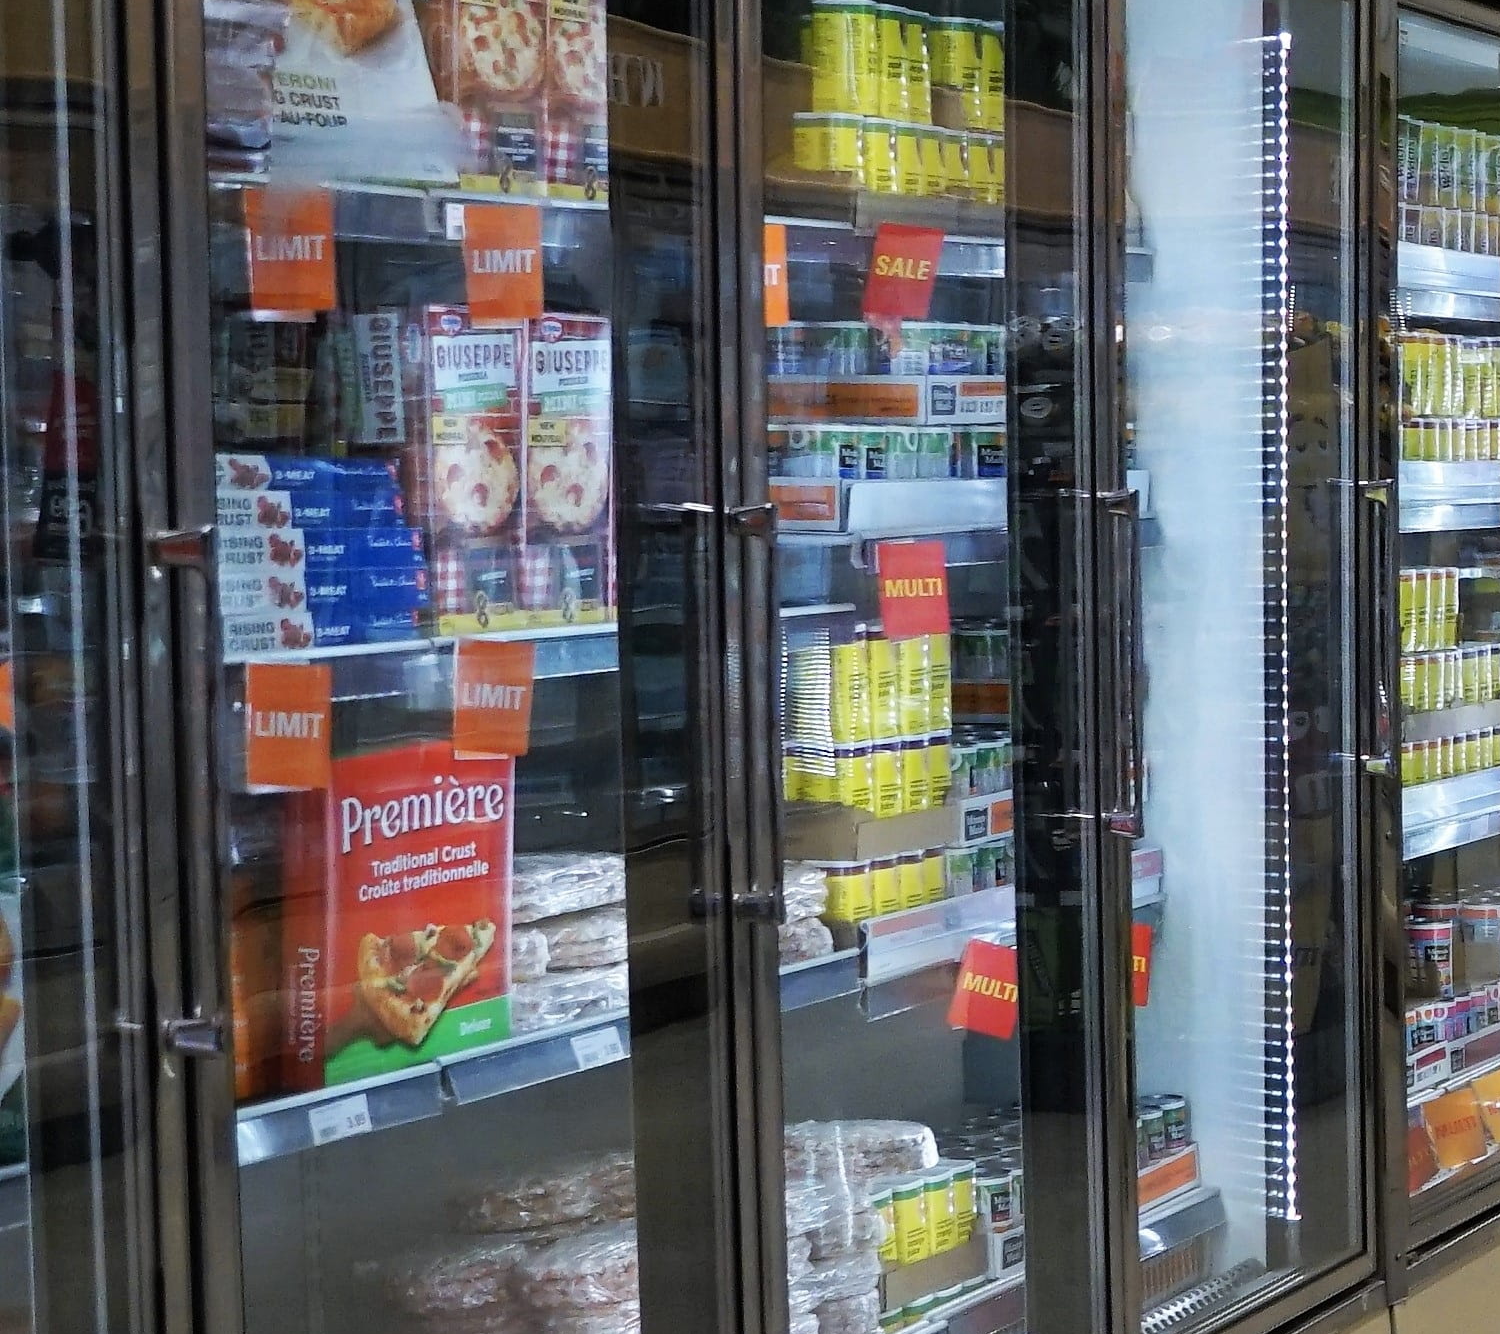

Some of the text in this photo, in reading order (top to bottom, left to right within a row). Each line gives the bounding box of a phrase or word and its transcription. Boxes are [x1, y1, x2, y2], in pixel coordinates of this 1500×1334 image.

[289, 94, 341, 111] CRUST
[257, 235, 325, 262] LIMIT
[473, 249, 536, 274] LIMIT
[876, 255, 931, 281] SALE
[436, 342, 512, 370] GIUSEPPE
[535, 349, 608, 372] GIUSEPPE
[885, 578, 943, 598] MULTI
[229, 621, 275, 636] RISING
[228, 636, 276, 653] CRUST
[464, 683, 525, 710] LIMIT
[255, 710, 323, 737] LIMIT
[341, 777, 504, 854] Première
[371, 842, 477, 877] Traditional Crust
[359, 860, 489, 903] Croûte traditionnelle
[300, 946, 320, 1062] Première
